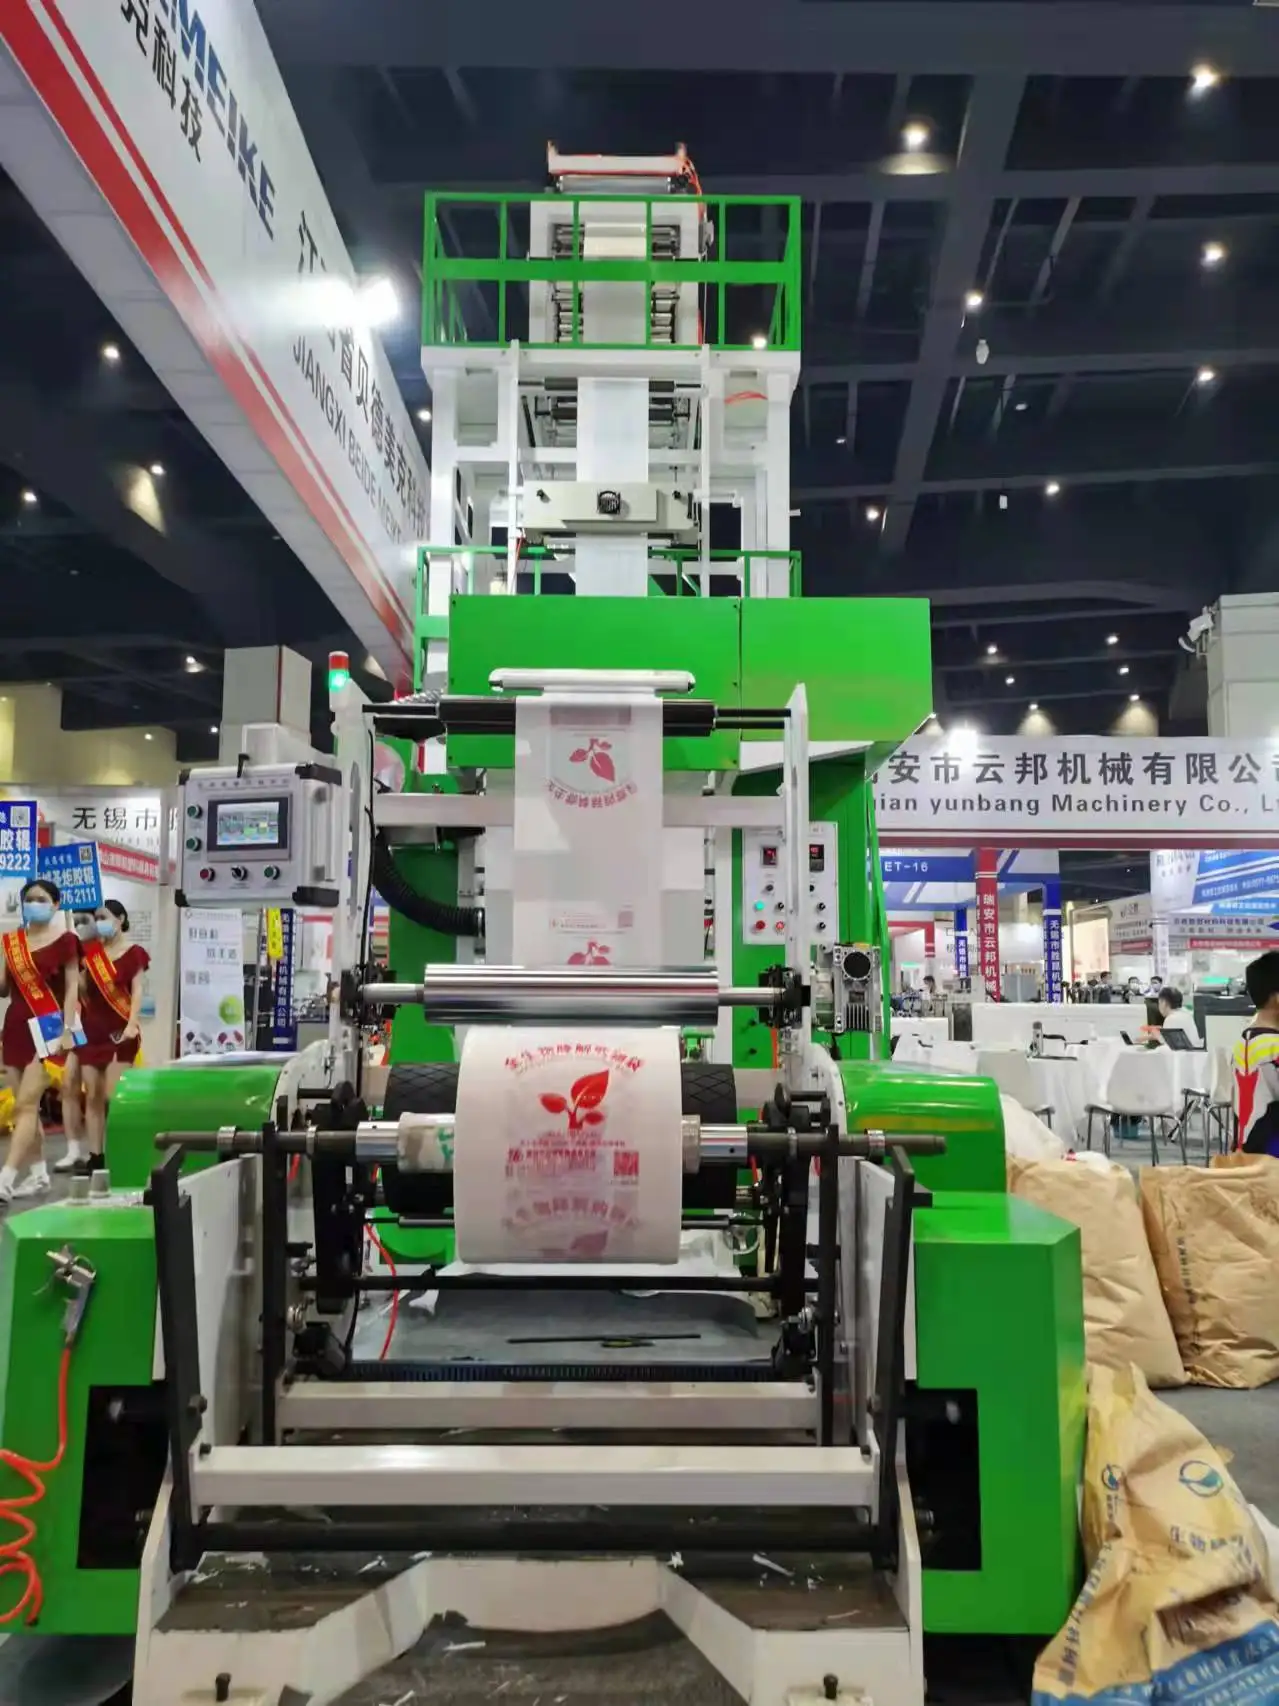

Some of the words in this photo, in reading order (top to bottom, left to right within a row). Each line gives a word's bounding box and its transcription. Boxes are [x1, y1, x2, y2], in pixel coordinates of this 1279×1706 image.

[293, 335, 346, 450] JIANGXI
[872, 751, 1279, 786] 安市云邦机械有限公
[874, 793, 917, 811] ian
[930, 794, 1040, 816] yunbang
[1051, 793, 1187, 816] Machinery
[884, 861, 929, 873] ET-16
[983, 893, 998, 1002] 瑞安市云邦机械
